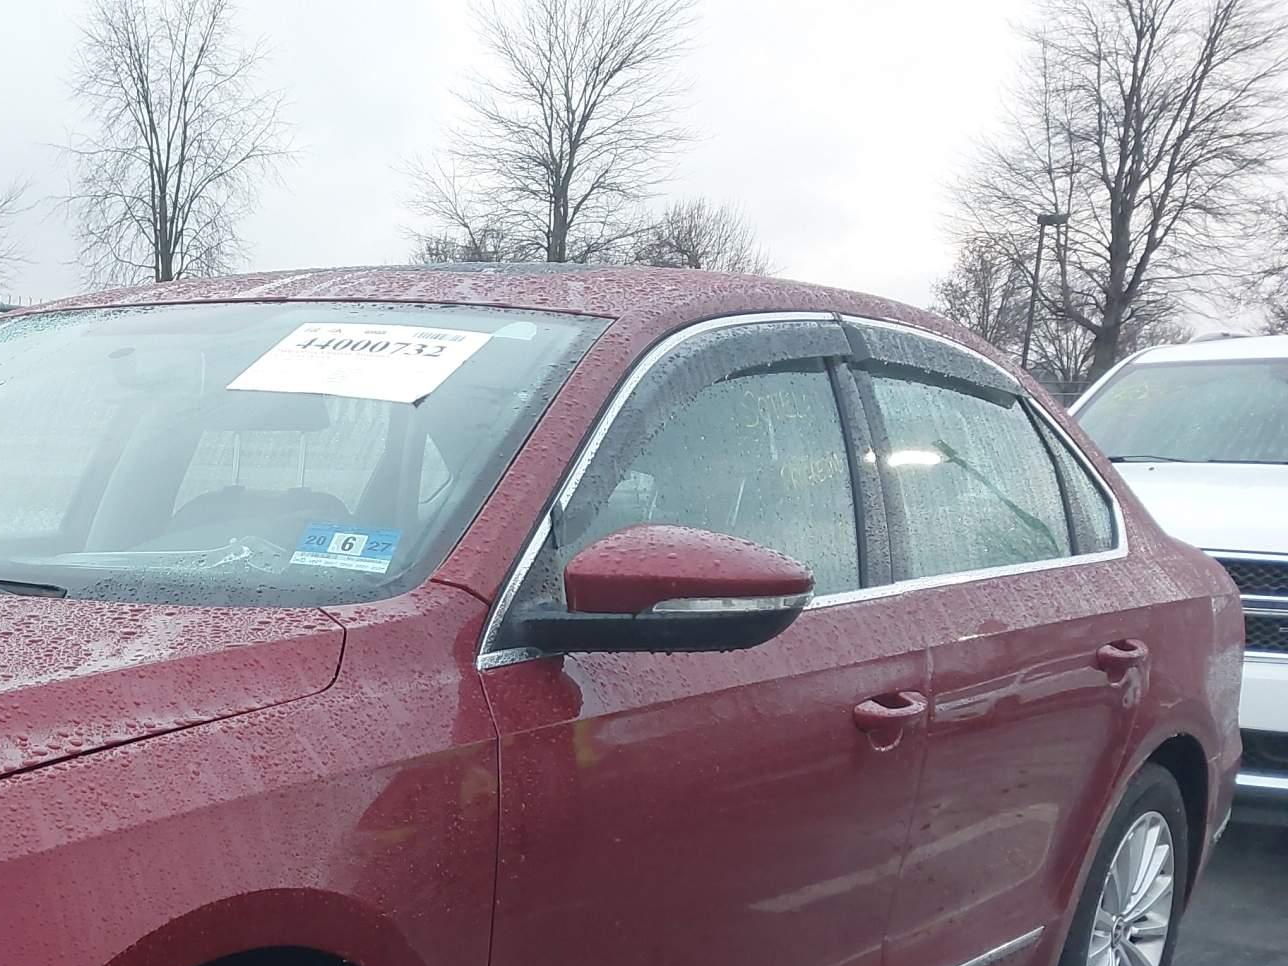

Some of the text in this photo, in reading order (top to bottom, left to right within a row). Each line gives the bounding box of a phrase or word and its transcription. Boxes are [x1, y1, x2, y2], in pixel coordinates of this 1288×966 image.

[296, 337, 448, 358] 44000732
[305, 535, 393, 553] 20 6 27
